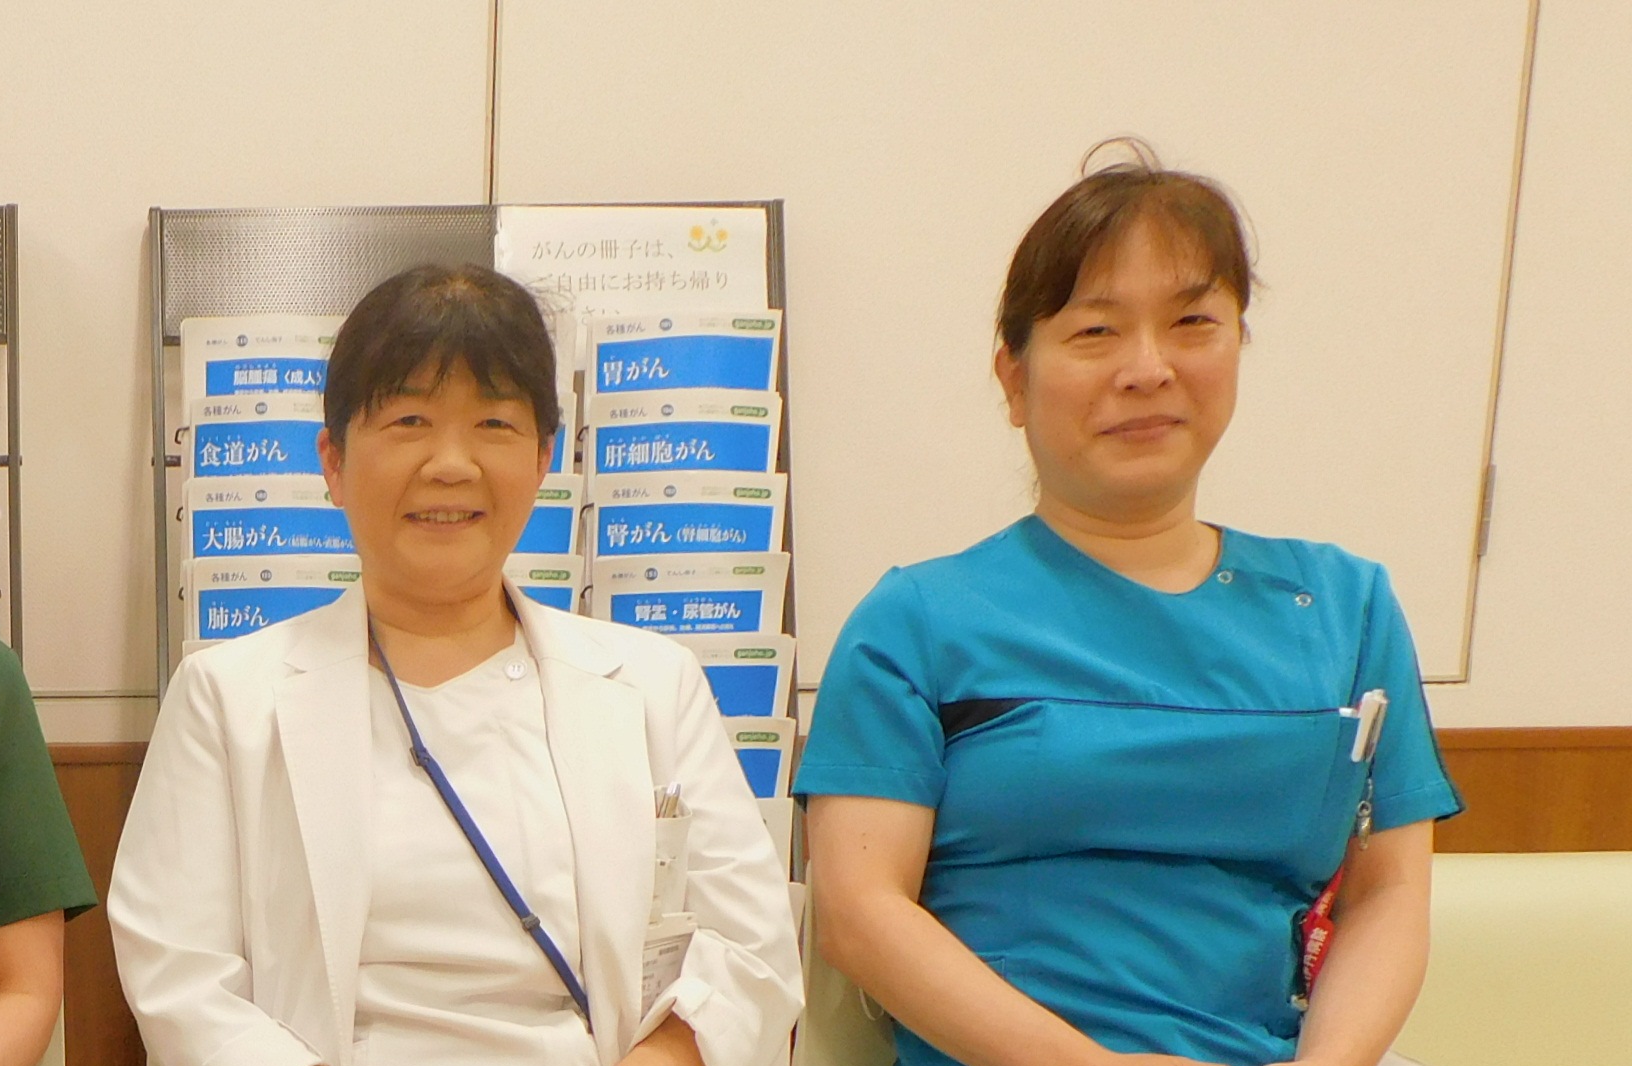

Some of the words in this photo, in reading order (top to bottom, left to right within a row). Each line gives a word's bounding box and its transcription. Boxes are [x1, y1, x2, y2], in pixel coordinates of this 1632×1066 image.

[531, 239, 674, 261] がんの冊子は、
[603, 357, 670, 386] 胃がん
[200, 439, 289, 467] 食道がん
[604, 440, 716, 468] 肝細胞がん
[202, 523, 287, 550] 大腸がん
[606, 521, 672, 547] 腎がん
[207, 603, 270, 631] 肺がん
